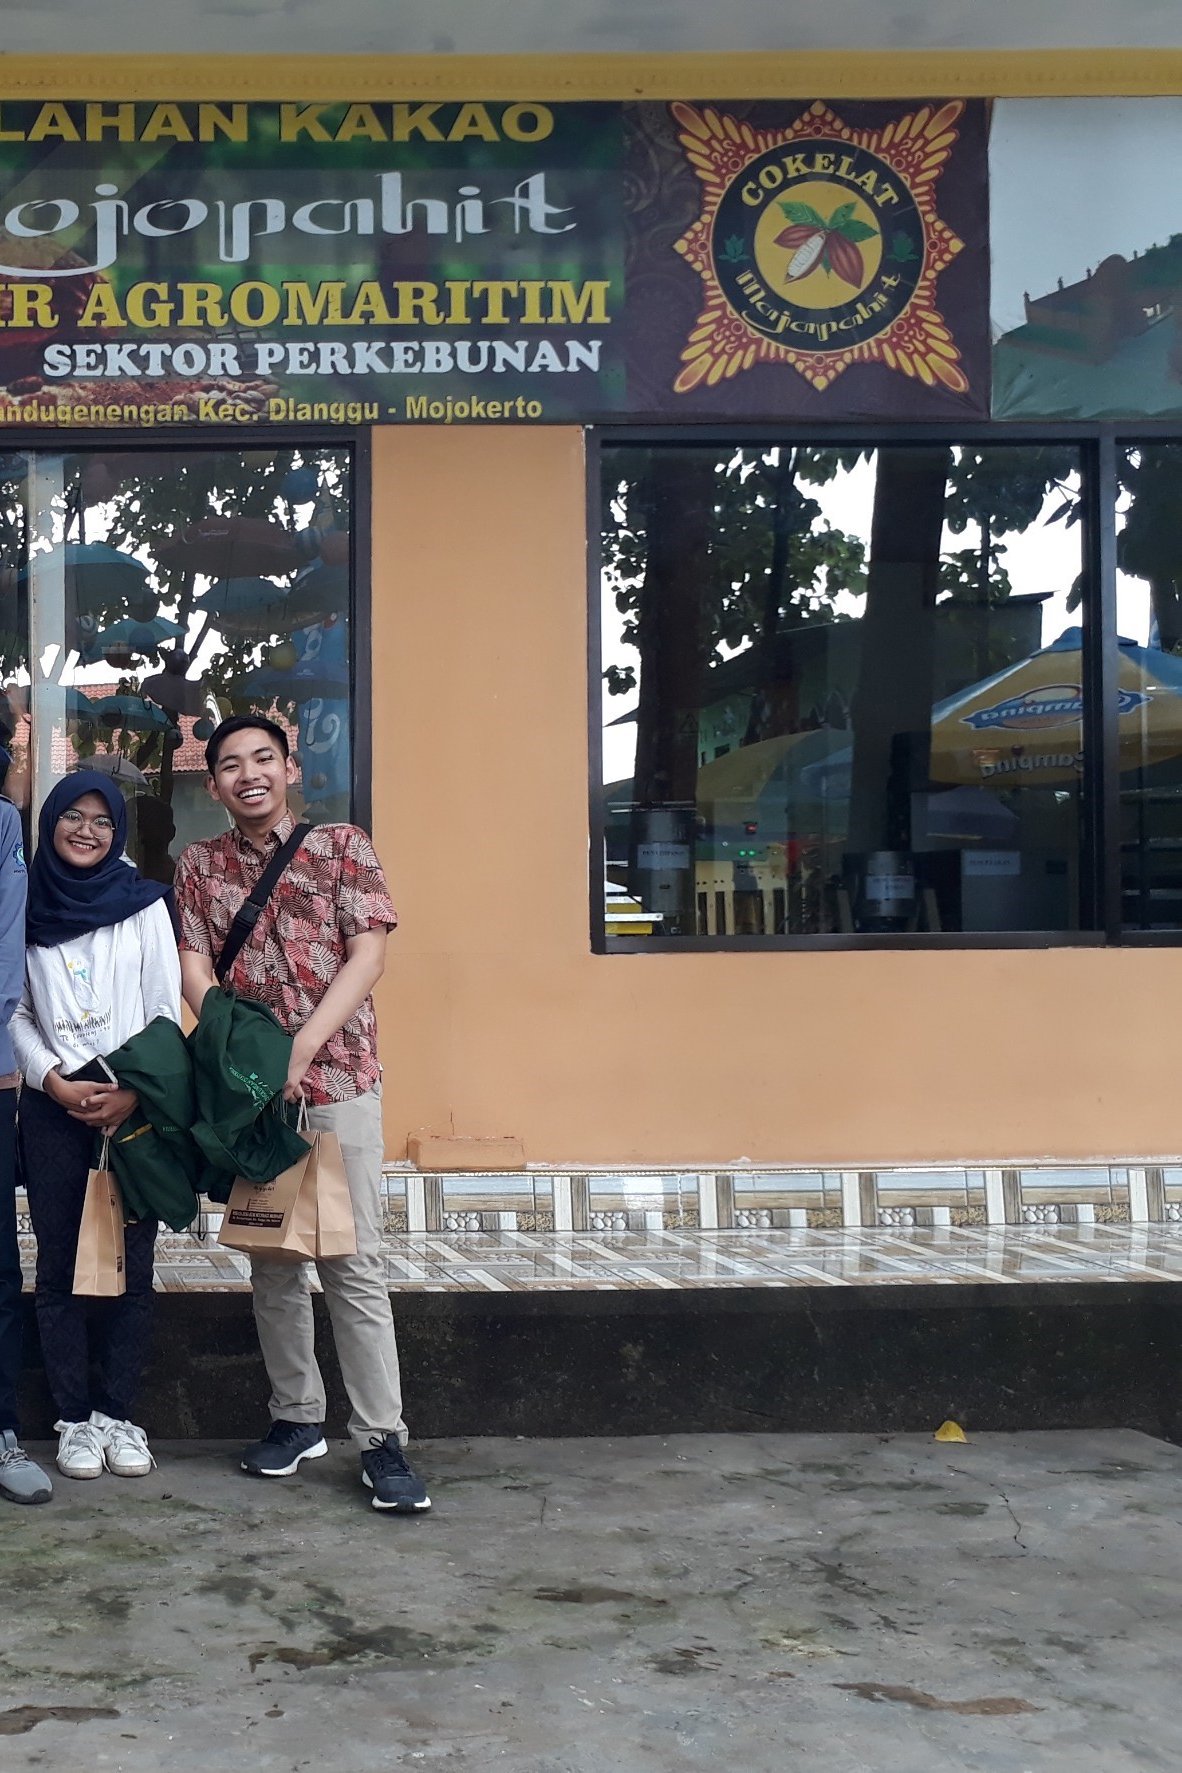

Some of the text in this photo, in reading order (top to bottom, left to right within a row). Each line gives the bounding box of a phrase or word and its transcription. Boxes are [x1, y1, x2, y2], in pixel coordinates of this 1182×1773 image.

[278, 102, 555, 142] KAKAO
[740, 152, 900, 208] COKELAT
[76, 280, 612, 328] AGROMARITIM
[43, 339, 603, 378] SEKTOR PERKEBUNAN
[197, 398, 260, 422] Kec.
[405, 395, 543, 425] Mojokerto
